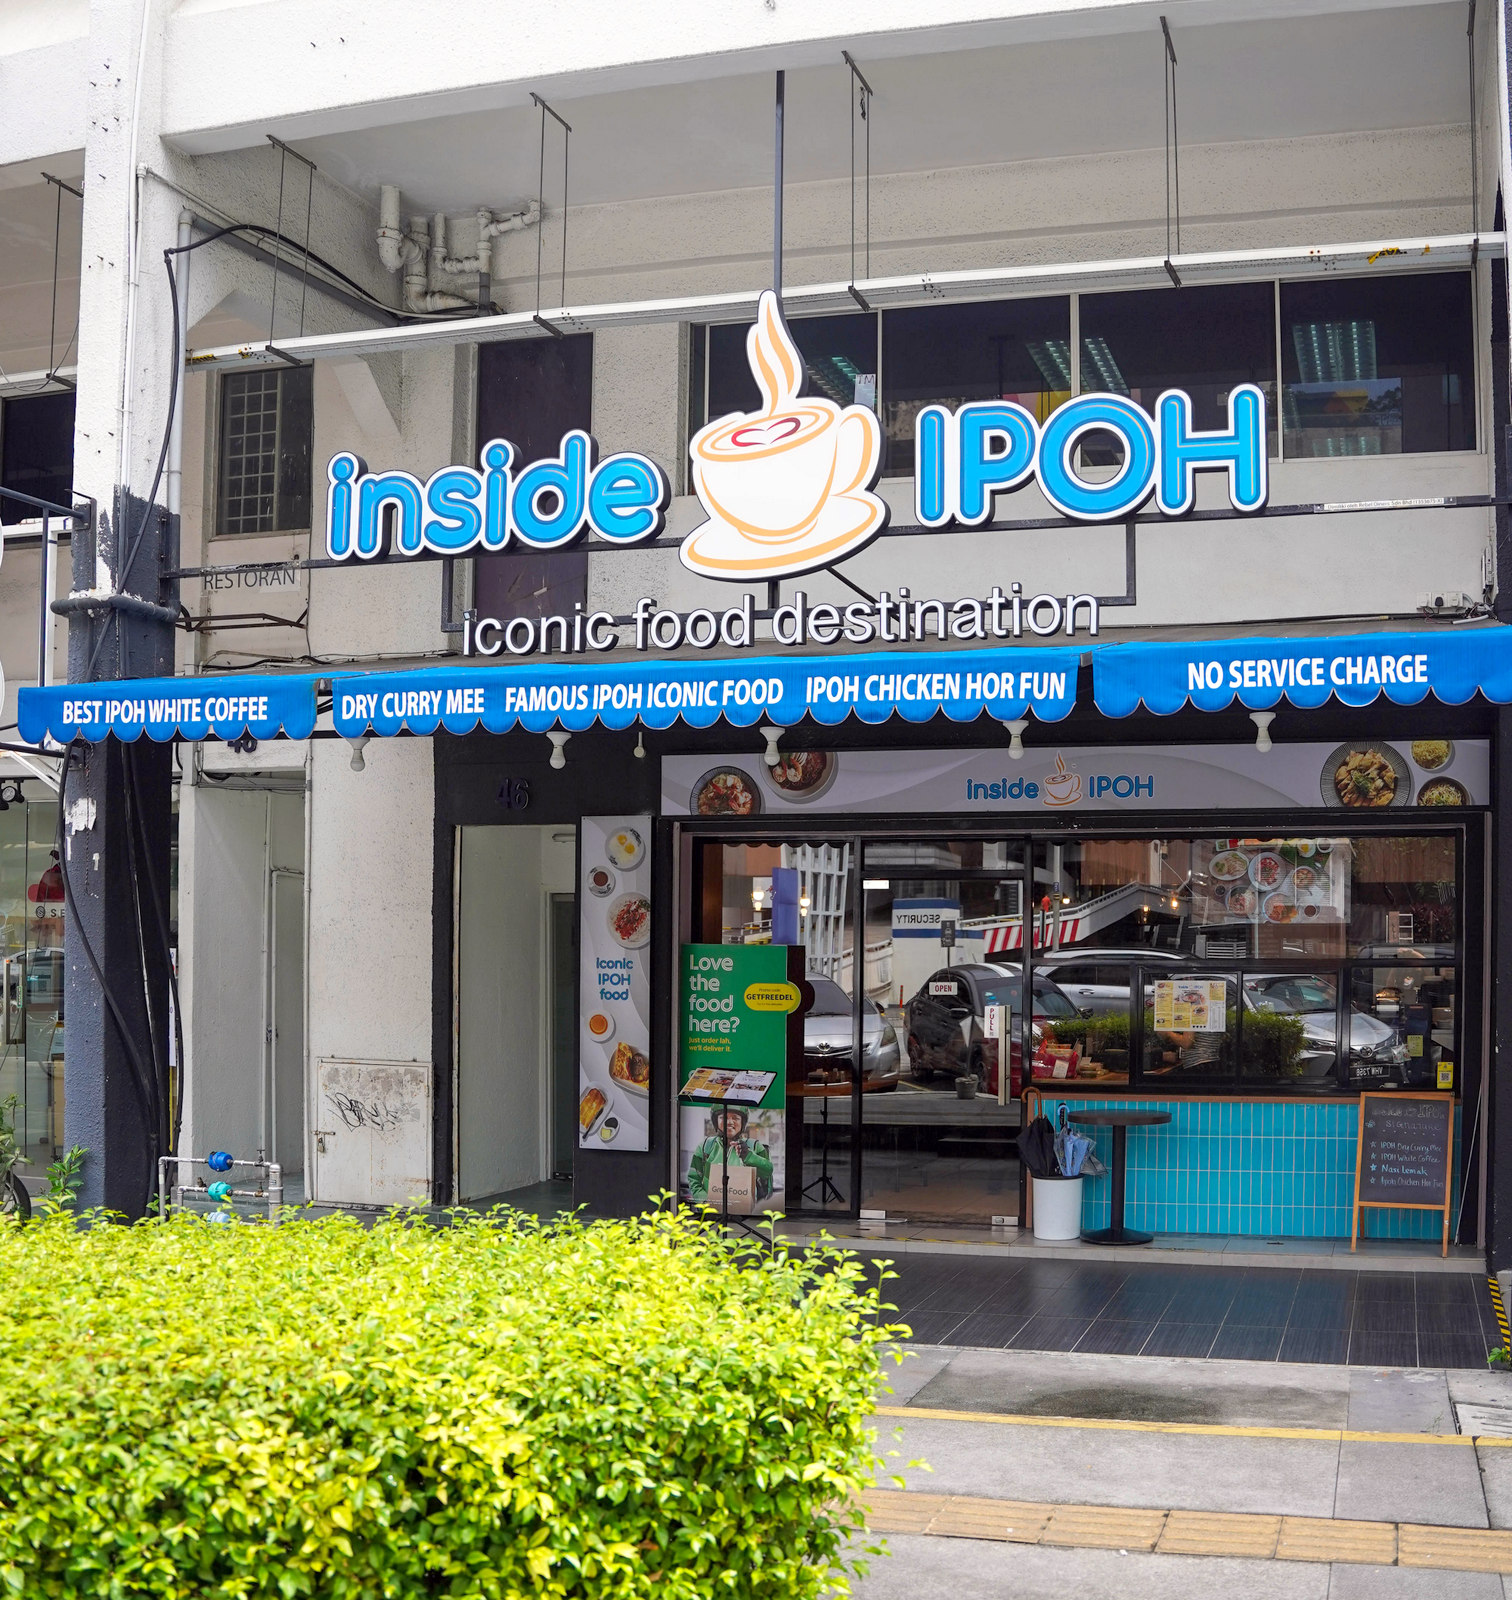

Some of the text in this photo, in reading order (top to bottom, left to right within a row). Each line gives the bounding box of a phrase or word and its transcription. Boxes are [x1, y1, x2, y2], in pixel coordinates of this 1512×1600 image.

[327, 383, 1267, 560] inside IPOH
[204, 567, 295, 590] RESTORAN
[463, 582, 1099, 656] iconic food destination
[1188, 654, 1428, 690] NO SERVICE CHARGE
[505, 678, 784, 712] FAMOUS IPOH ICONIC FOOD
[806, 672, 1066, 703] IPOH CHICKEN HOR FUN
[63, 696, 268, 724] BEST IPOH WHITE COFFEE
[341, 688, 485, 720] DRY CURRY MEE
[496, 777, 529, 810] 46
[966, 775, 1154, 800] inside IPOH
[596, 957, 634, 969] iconic
[689, 954, 734, 971] Love
[598, 973, 631, 985] IPOH
[689, 973, 720, 991] the
[934, 985, 952, 993] OPEN
[600, 988, 629, 1000] food
[689, 994, 734, 1013] food
[746, 993, 794, 1001] GETFREEDEL
[689, 1014, 741, 1033] here?
[712, 1185, 748, 1196] GraFood
